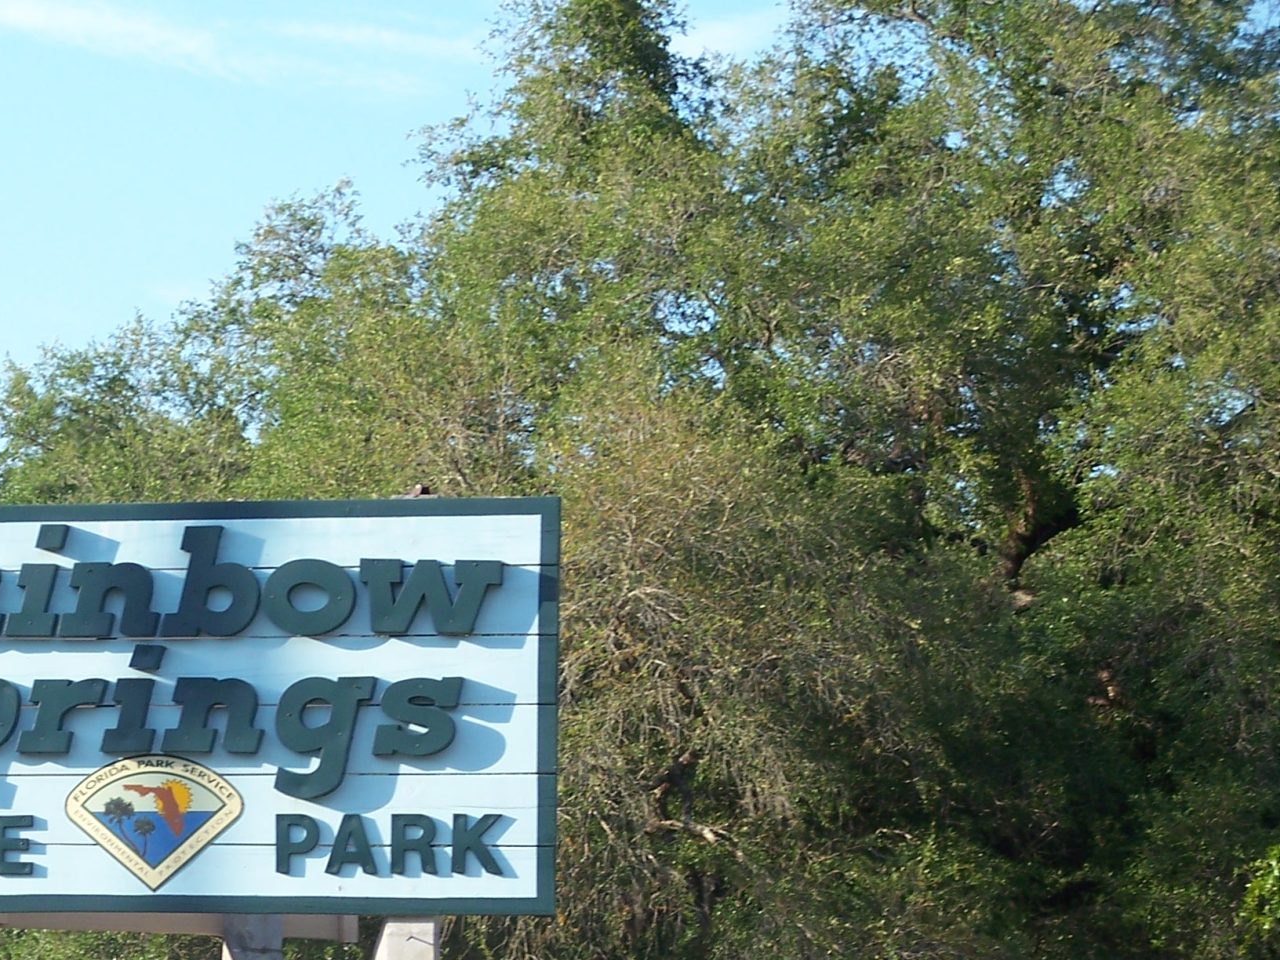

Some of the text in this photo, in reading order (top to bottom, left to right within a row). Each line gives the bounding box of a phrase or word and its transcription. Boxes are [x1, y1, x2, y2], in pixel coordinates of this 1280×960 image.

[73, 758, 236, 803] FLORIDA PARK SERVICE
[73, 809, 235, 877] ENVIRONMENTAL PROTECTION
[275, 813, 504, 876] PARK
